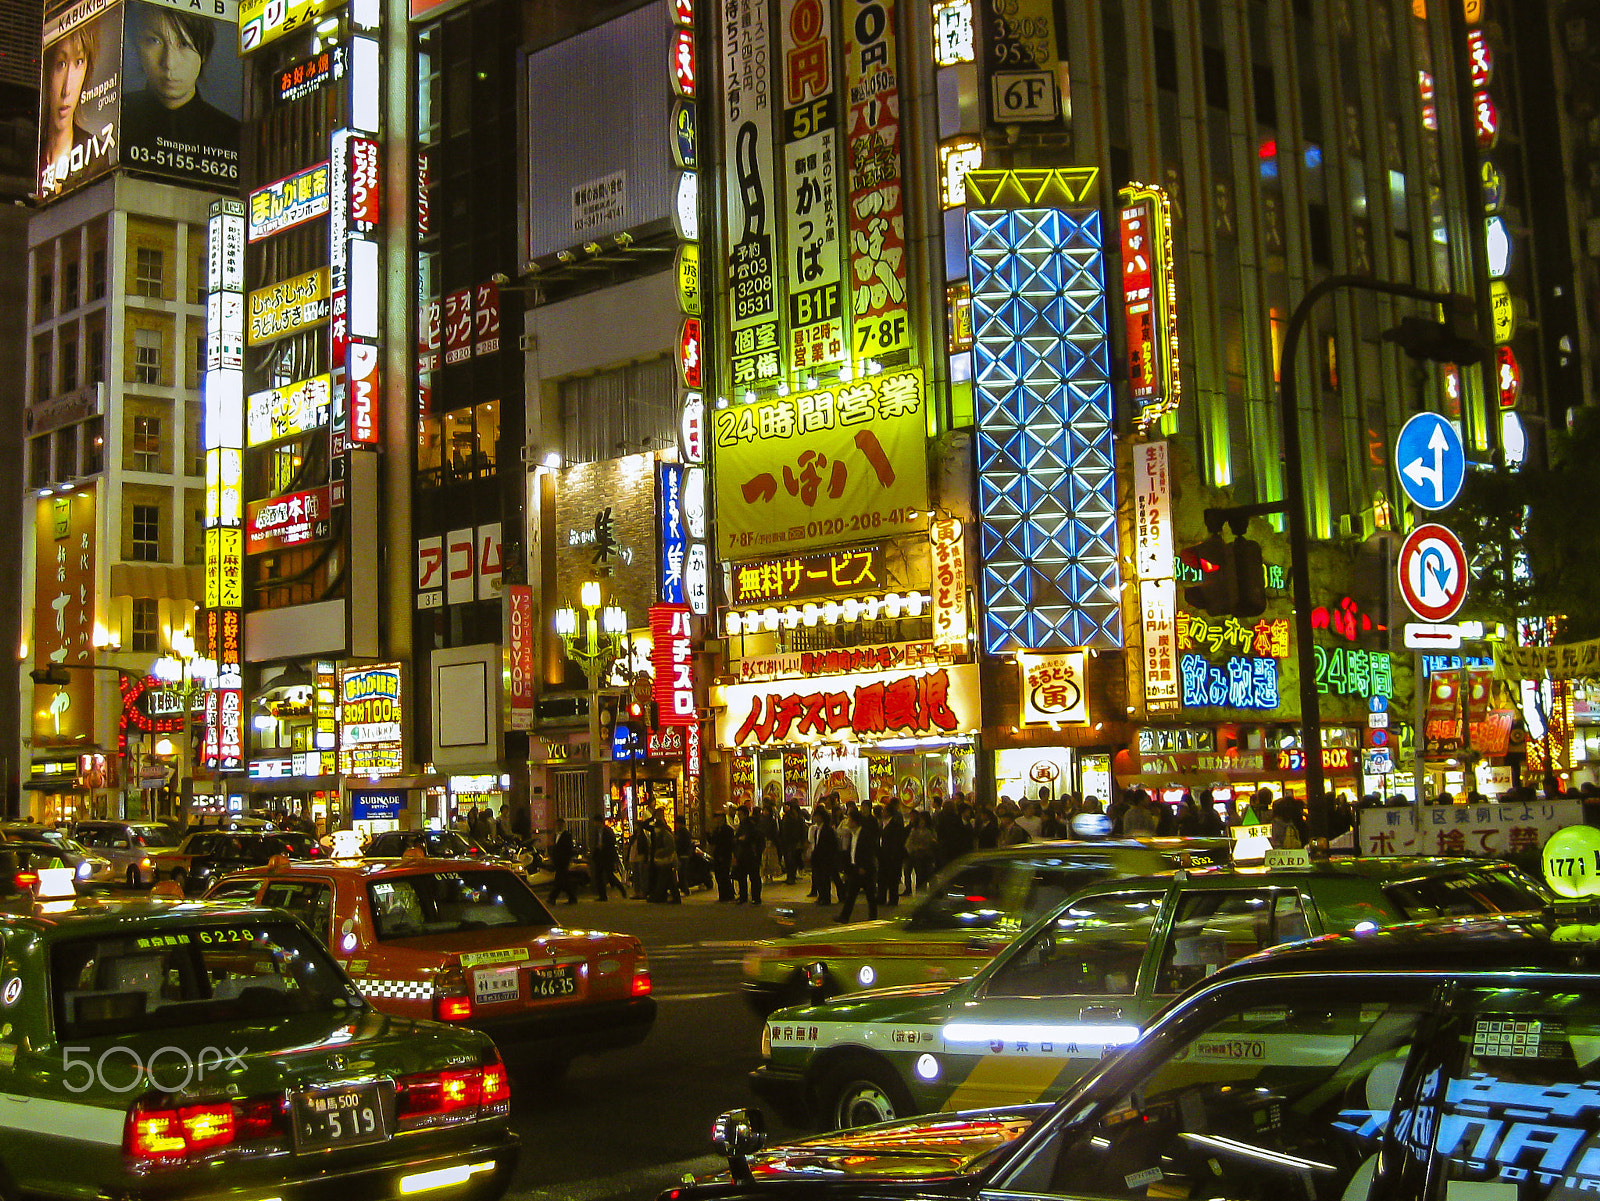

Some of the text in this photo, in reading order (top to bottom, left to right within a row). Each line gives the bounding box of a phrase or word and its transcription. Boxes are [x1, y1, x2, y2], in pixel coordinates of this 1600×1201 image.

[993, 16, 1051, 41] 3208
[80, 74, 118, 105] Smappal
[97, 91, 117, 112] group
[1004, 78, 1046, 110] 6F
[793, 99, 828, 139] 5F
[155, 136, 239, 161] Smappal HYPER
[853, 132, 884, 152] タイム
[129, 146, 239, 180] 03-5155-5626
[794, 153, 818, 175] 新宿
[854, 147, 897, 174] サービス
[853, 166, 897, 191] いろいろ
[251, 168, 328, 222] まんが喫茶
[737, 242, 761, 262] 予約
[856, 190, 905, 316] つぼ八
[1127, 219, 1148, 273] つぼ八
[252, 271, 319, 315] しゃぶしゃぶ
[738, 274, 772, 298] 3208
[429, 286, 491, 323] カラオケ
[738, 295, 771, 317] 9531
[797, 286, 838, 325] B1F
[251, 304, 302, 340] うどんすき
[428, 307, 500, 350] ビックワン
[734, 324, 778, 354] 個室
[793, 339, 842, 368] 営業中
[734, 353, 778, 384] 完備
[356, 380, 372, 428] アコム
[717, 372, 921, 448] 24時間営業
[740, 429, 896, 507] つぼ八
[1145, 446, 1159, 506] 生ビール
[420, 536, 502, 587] アコム
[739, 551, 877, 600] 無料サービス
[425, 595, 438, 606] 3F
[936, 544, 954, 630] まるとら
[511, 594, 523, 697] YOU YOU
[1158, 634, 1171, 682] 炭火焼鳥
[671, 611, 695, 715] パチスロ
[1028, 666, 1075, 687] まるとら
[1148, 647, 1160, 682] 99円
[1314, 645, 1393, 700] 24時間
[1041, 685, 1068, 708] 寅
[1180, 653, 1280, 709] 飲み放題
[344, 698, 400, 723] 30分100円
[1321, 749, 1350, 769] BOX
[1386, 803, 1556, 824] 新区条例により
[1247, 827, 1270, 838] 東京
[1268, 856, 1306, 867] CARD
[1549, 857, 1586, 877] 1771
[199, 929, 255, 945] 6228
[771, 1026, 922, 1044] 東京無線 (渋谷)
[1227, 1042, 1263, 1058] 1370
[338, 1093, 359, 1109] 500
